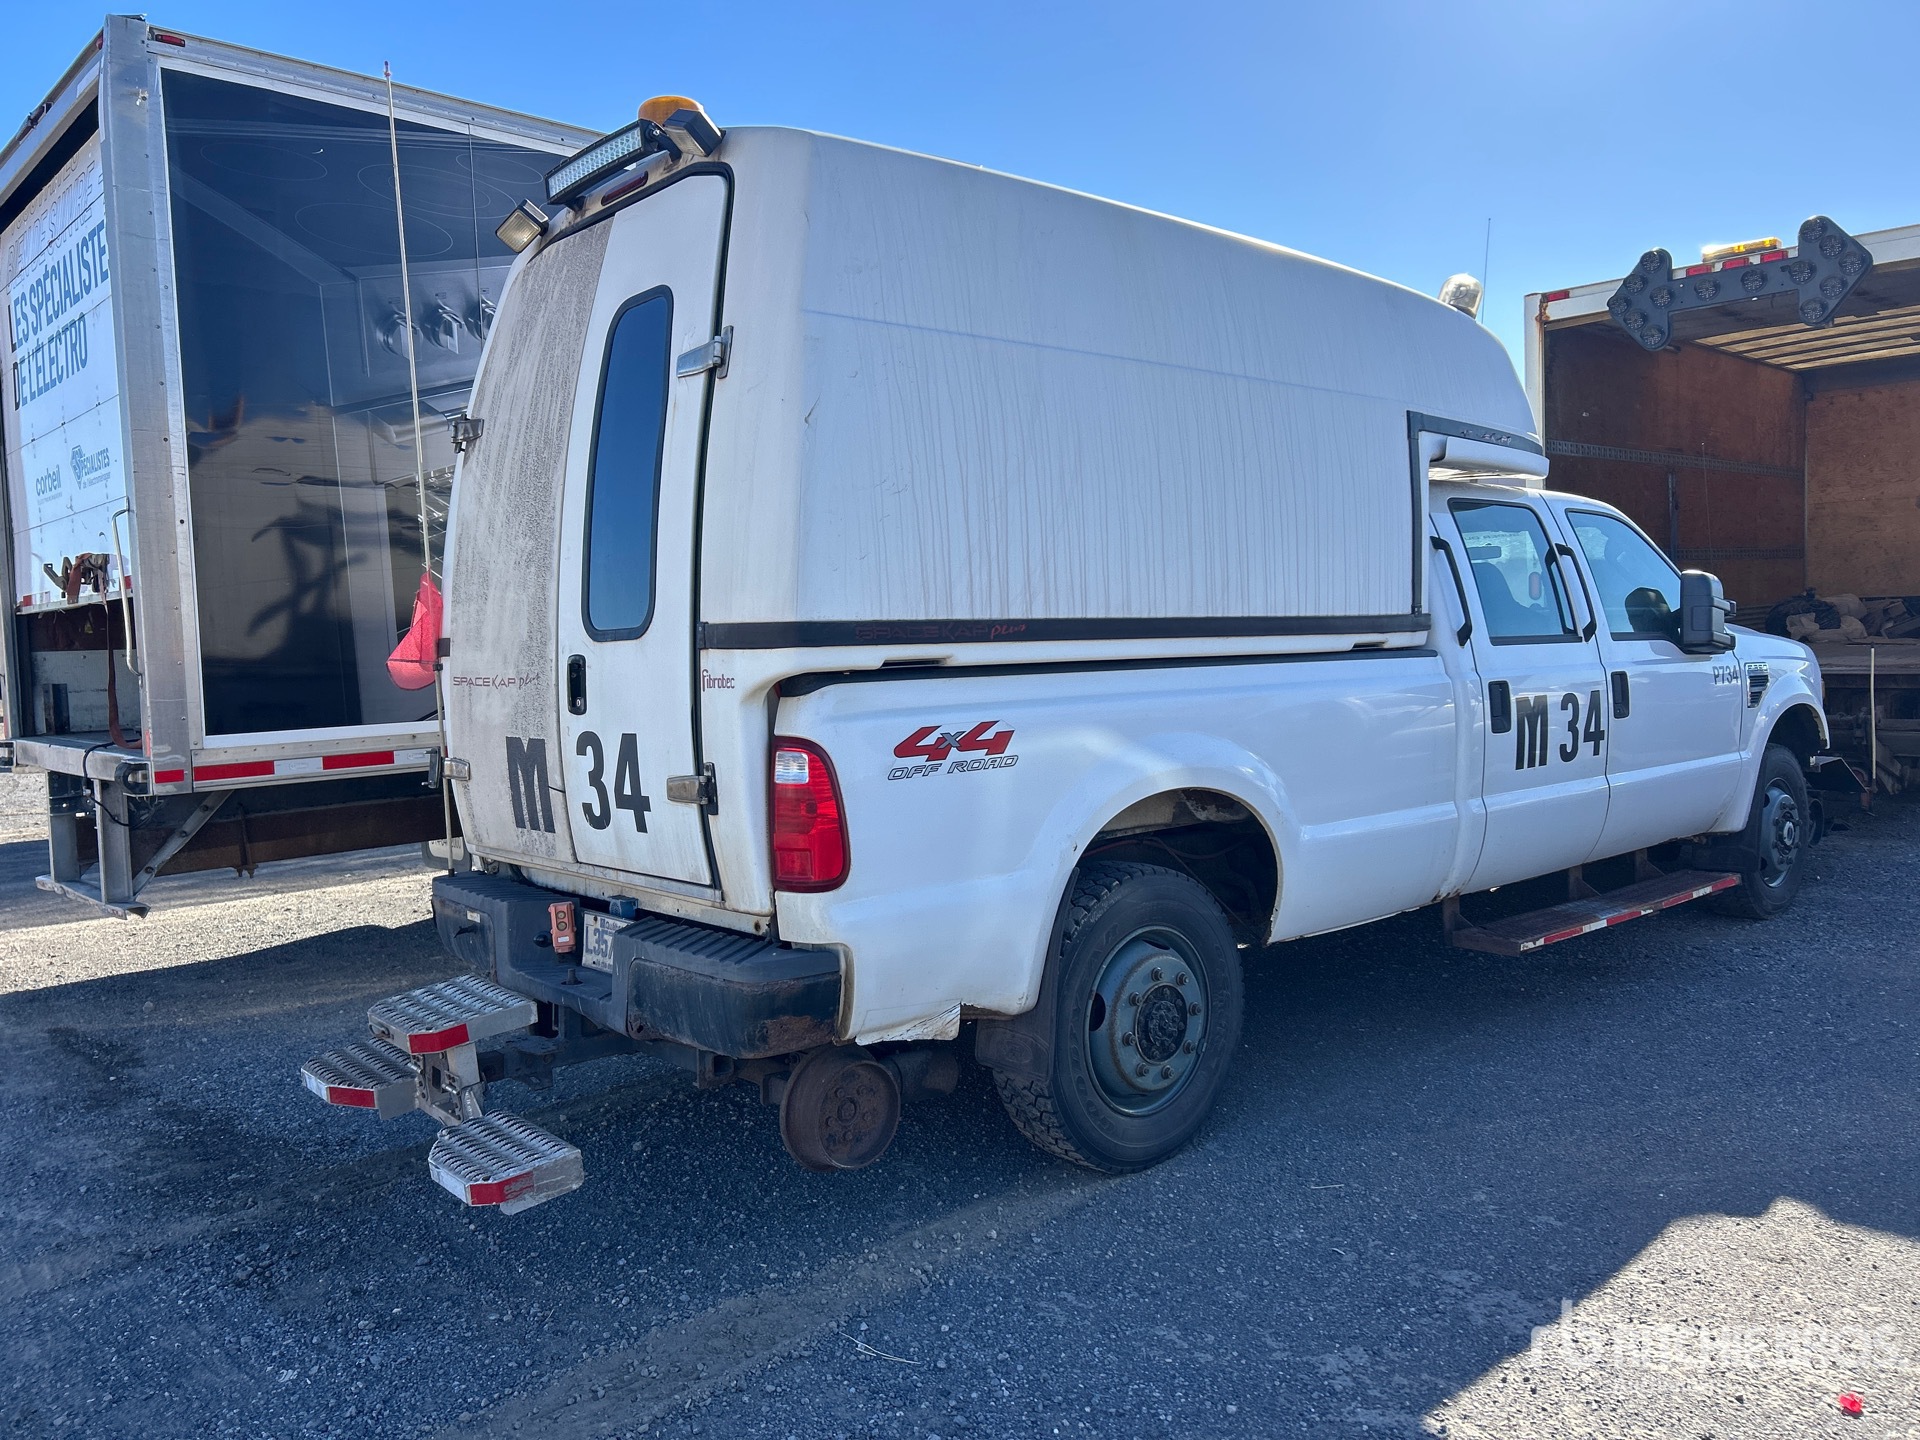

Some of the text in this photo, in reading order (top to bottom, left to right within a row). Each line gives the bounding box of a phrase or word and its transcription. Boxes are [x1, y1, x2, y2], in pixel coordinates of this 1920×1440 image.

[8, 219, 109, 353] LES SPÉCIALISTE
[13, 311, 88, 411] DE L'ÉLECTRO
[36, 464, 62, 496] corbeil
[453, 674, 516, 690] SPACEKAP
[1712, 665, 1739, 685] P734
[1515, 690, 1605, 770] M 34
[505, 730, 652, 834] M 34
[887, 755, 1019, 781] OFF ROAD
